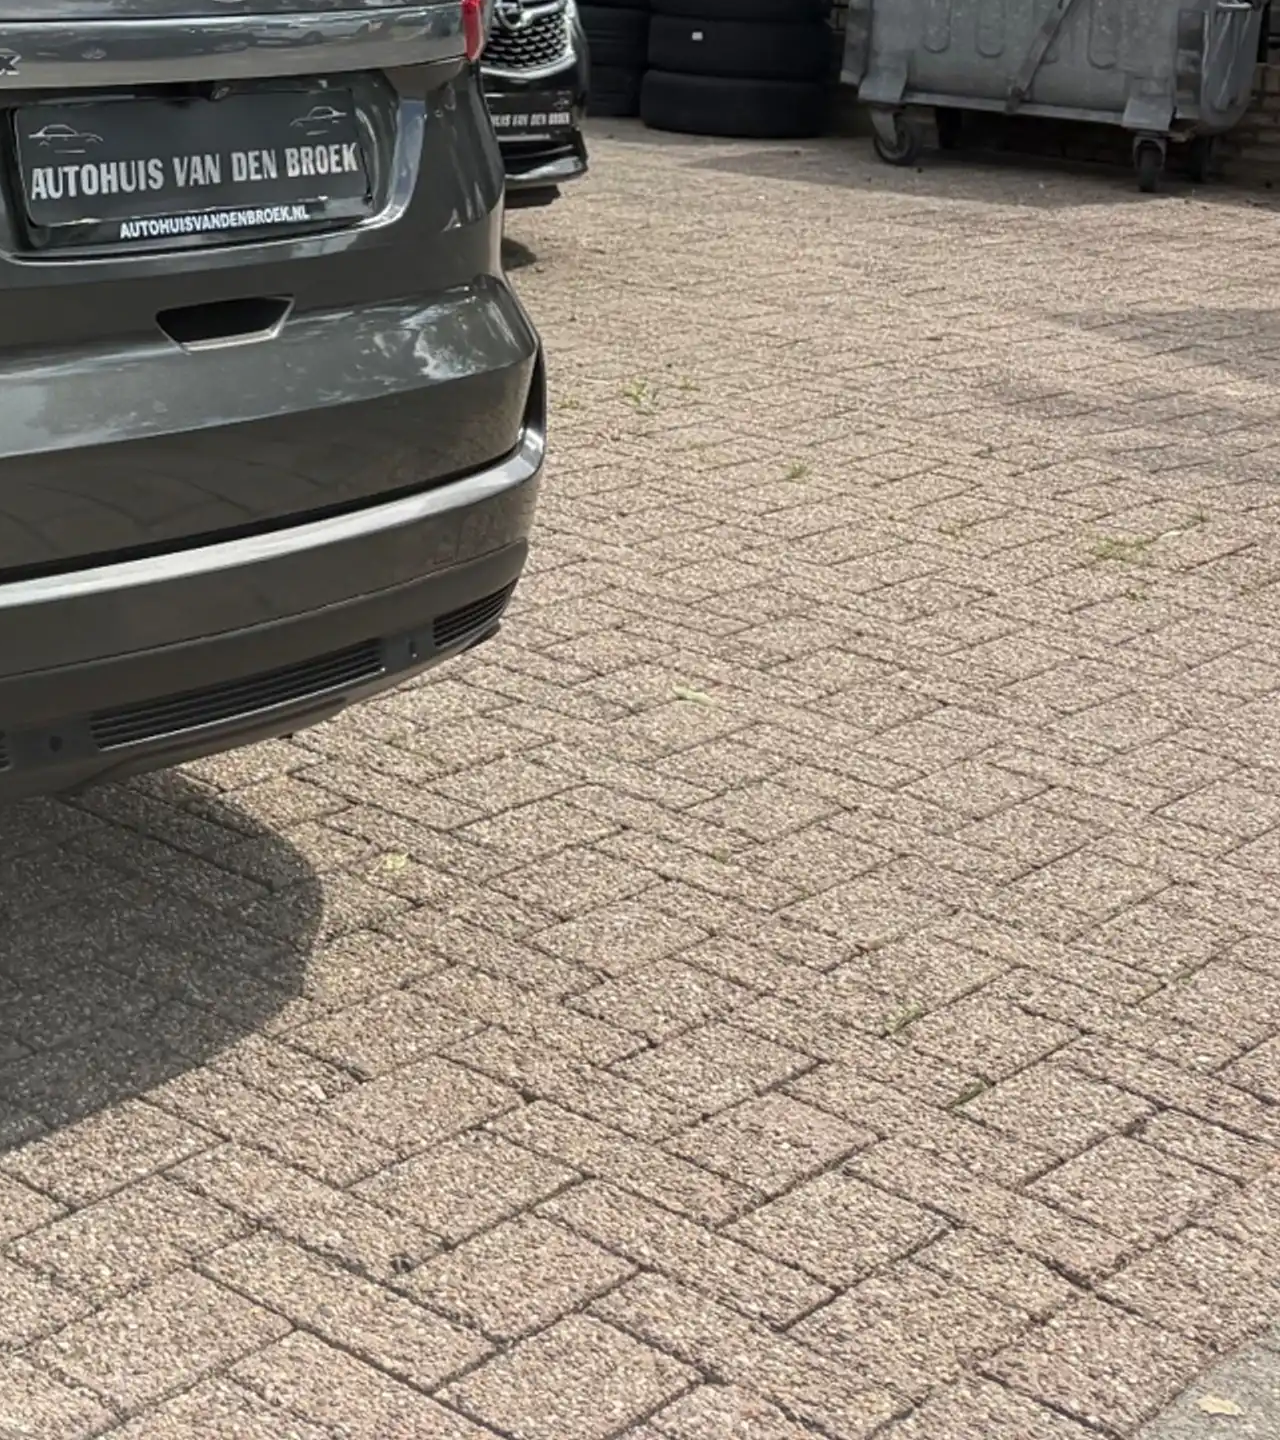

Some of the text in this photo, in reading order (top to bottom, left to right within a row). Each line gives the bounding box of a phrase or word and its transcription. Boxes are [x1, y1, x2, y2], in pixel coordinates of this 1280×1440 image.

[31, 141, 360, 201] AUTOHUIS VAN DEN BROEK
[119, 203, 311, 240] AUTOHUISVANDENBROEK.NL
